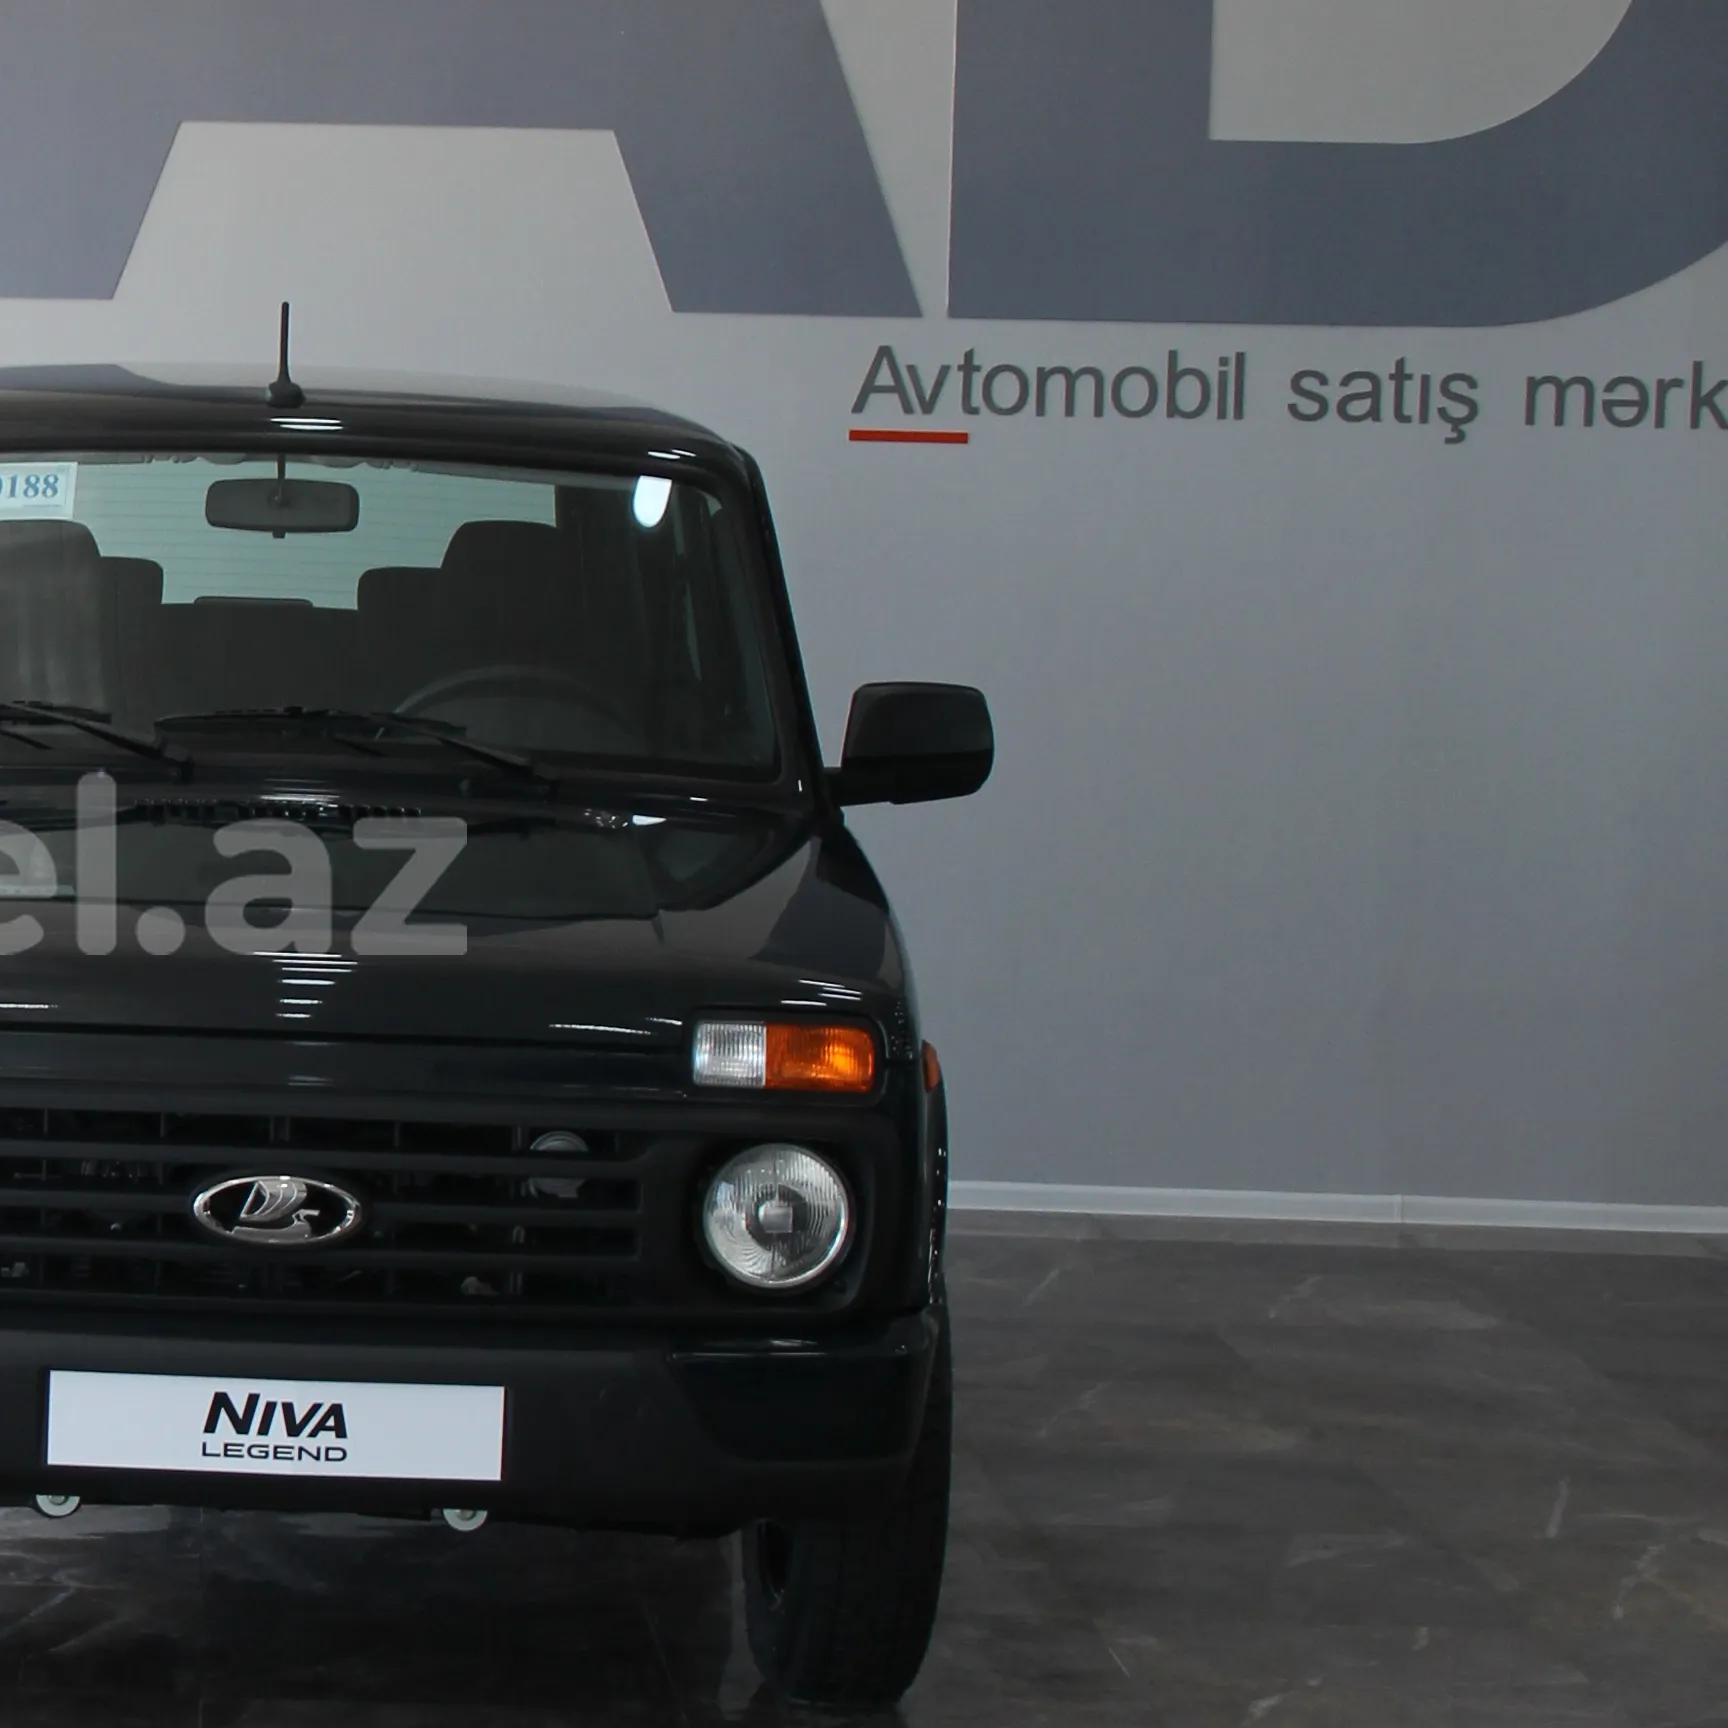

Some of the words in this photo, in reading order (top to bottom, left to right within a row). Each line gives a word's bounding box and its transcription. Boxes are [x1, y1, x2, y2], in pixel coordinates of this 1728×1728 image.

[850, 344, 1247, 421] Avtomobil
[1286, 355, 1480, 445] satış
[1523, 359, 1728, 430] mərk
[204, 1391, 348, 1439] NIVA
[202, 1441, 347, 1462] LEGEND
